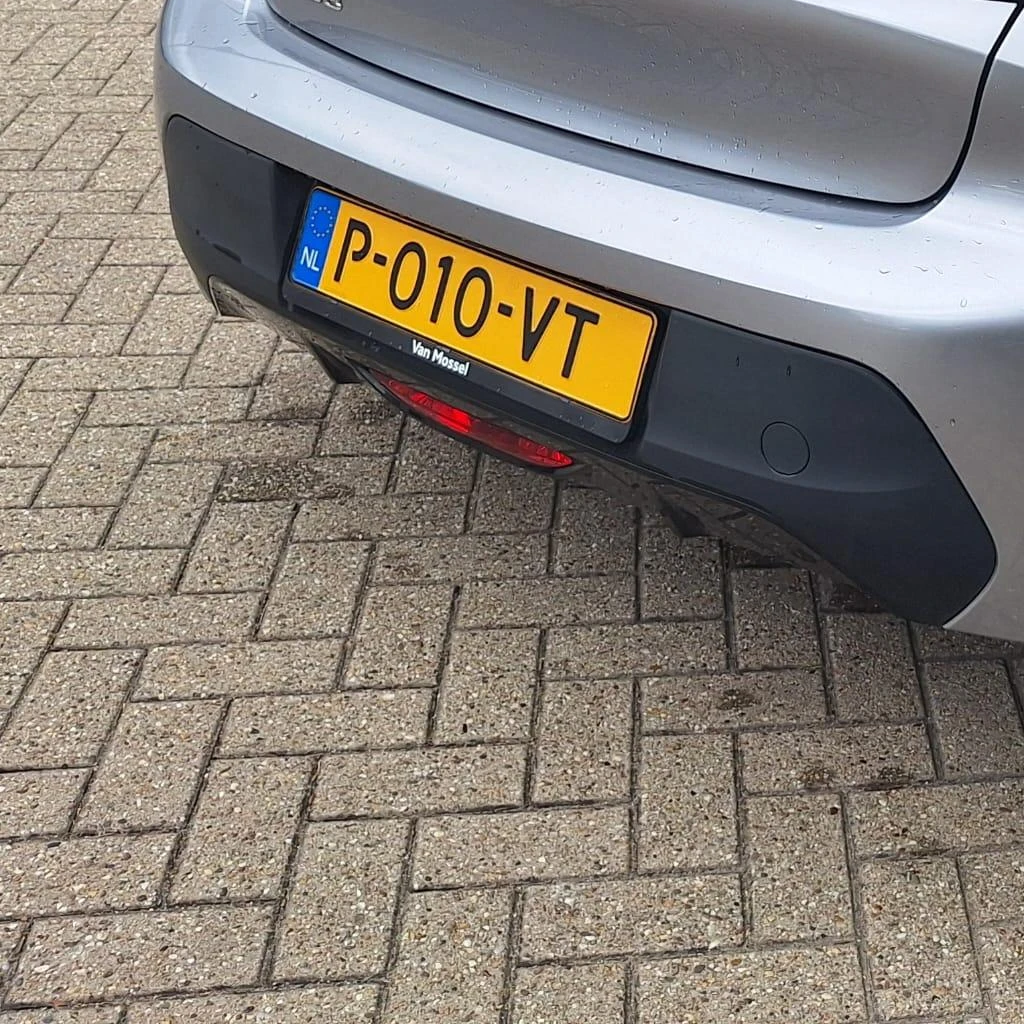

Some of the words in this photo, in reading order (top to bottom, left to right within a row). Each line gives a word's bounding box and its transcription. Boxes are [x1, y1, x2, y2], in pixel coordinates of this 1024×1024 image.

[300, 245, 320, 273] NL
[333, 217, 600, 379] P-010-VT
[412, 338, 431, 359] Van
[431, 348, 470, 376] Mossel
